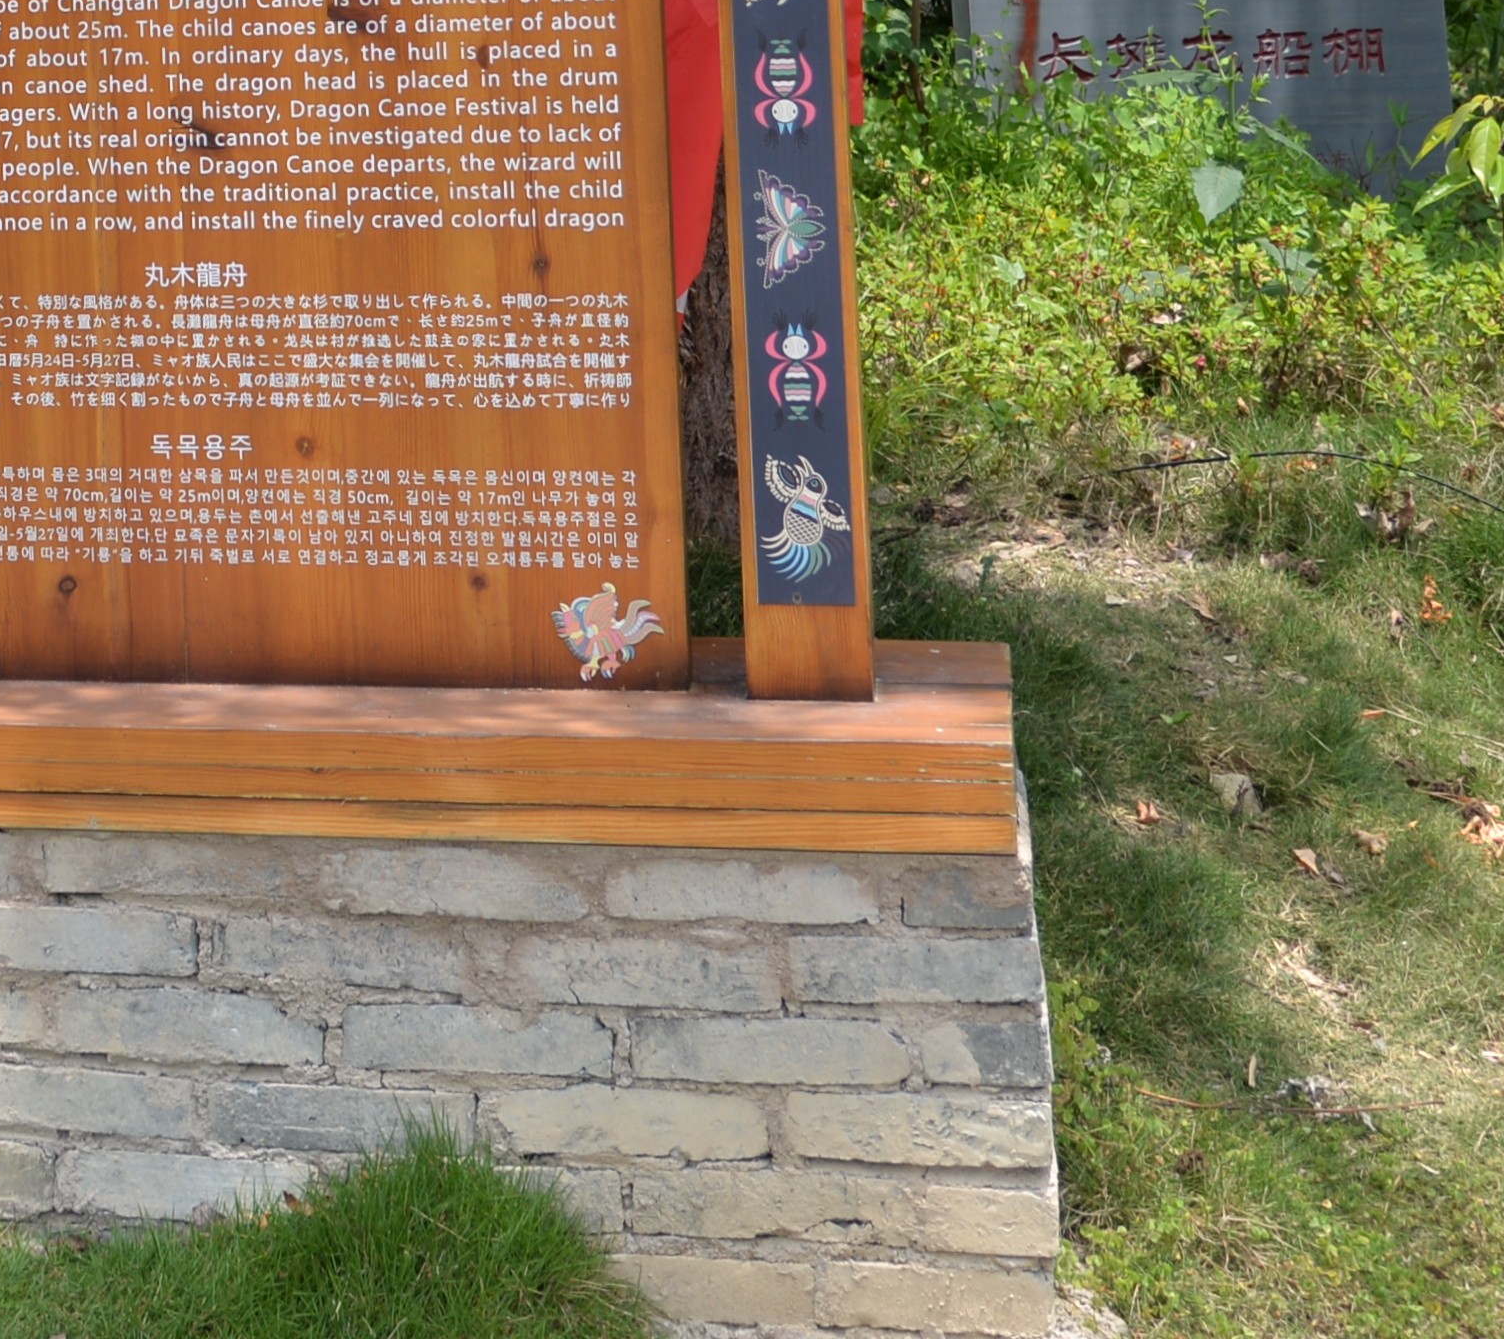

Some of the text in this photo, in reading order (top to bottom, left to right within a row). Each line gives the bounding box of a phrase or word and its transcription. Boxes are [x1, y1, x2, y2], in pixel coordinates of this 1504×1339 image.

[8, 21, 71, 41] about
[77, 20, 128, 40] 25m.
[135, 18, 175, 38] The
[182, 17, 233, 38] child
[241, 20, 317, 37] canoes
[324, 20, 358, 35] are
[365, 14, 388, 35] of
[394, 18, 407, 34] a
[414, 13, 514, 33] diameter
[520, 10, 544, 32] of
[550, 10, 617, 31] about
[24, 79, 88, 95] canoe
[98, 73, 154, 94] shed.
[164, 73, 204, 93] The
[215, 72, 292, 97] dragon
[303, 70, 357, 91] head
[368, 70, 386, 90] is
[396, 68, 469, 94] placed
[480, 68, 501, 88] in
[511, 67, 549, 87] the
[559, 66, 619, 87] drum
[68, 101, 119, 121] With
[126, 106, 138, 121] a
[146, 100, 193, 125] long
[202, 100, 281, 124] history,
[290, 99, 370, 123] Dragon
[378, 98, 447, 118] Canoe
[455, 95, 538, 116] Festival
[546, 95, 564, 115] is
[571, 93, 620, 115] held
[125, 183, 172, 203] with
[179, 183, 215, 203] the
[223, 182, 337, 202] traditional
[346, 181, 439, 206] practice,
[449, 180, 515, 200] install
[523, 180, 561, 200] the
[569, 178, 624, 199] child
[50, 212, 69, 231] in
[75, 216, 87, 231] a
[94, 216, 138, 233] row,
[144, 210, 184, 231] and
[191, 210, 256, 231] install
[262, 210, 298, 230] the
[303, 209, 365, 234] finely
[371, 208, 444, 229] craved
[450, 207, 537, 229] colorful
[544, 207, 625, 233] dragon
[144, 260, 249, 288] 丸木龍舟
[149, 433, 253, 461] 독목용주
